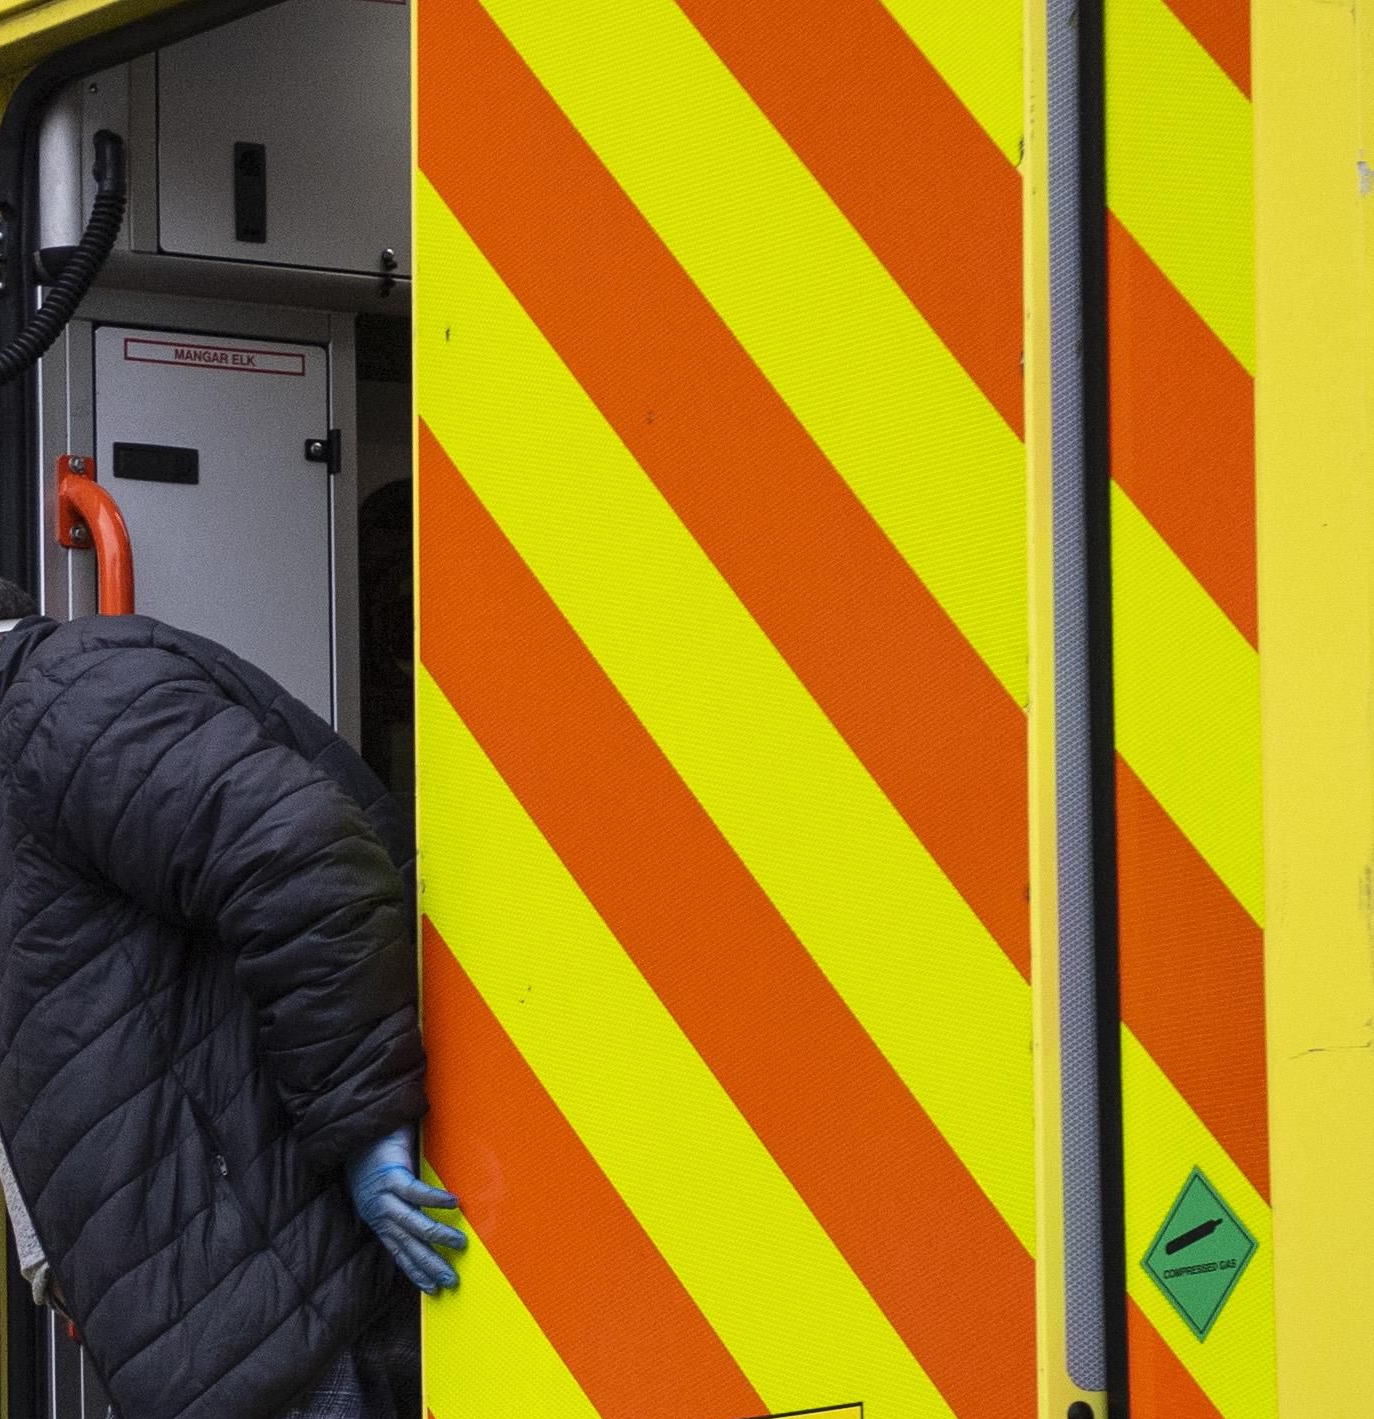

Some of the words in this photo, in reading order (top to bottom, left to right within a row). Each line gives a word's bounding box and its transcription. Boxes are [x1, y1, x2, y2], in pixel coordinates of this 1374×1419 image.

[174, 349, 229, 366] MANGAR
[232, 354, 256, 367] ELK
[1163, 1261, 1219, 1279] COMPRESSED
